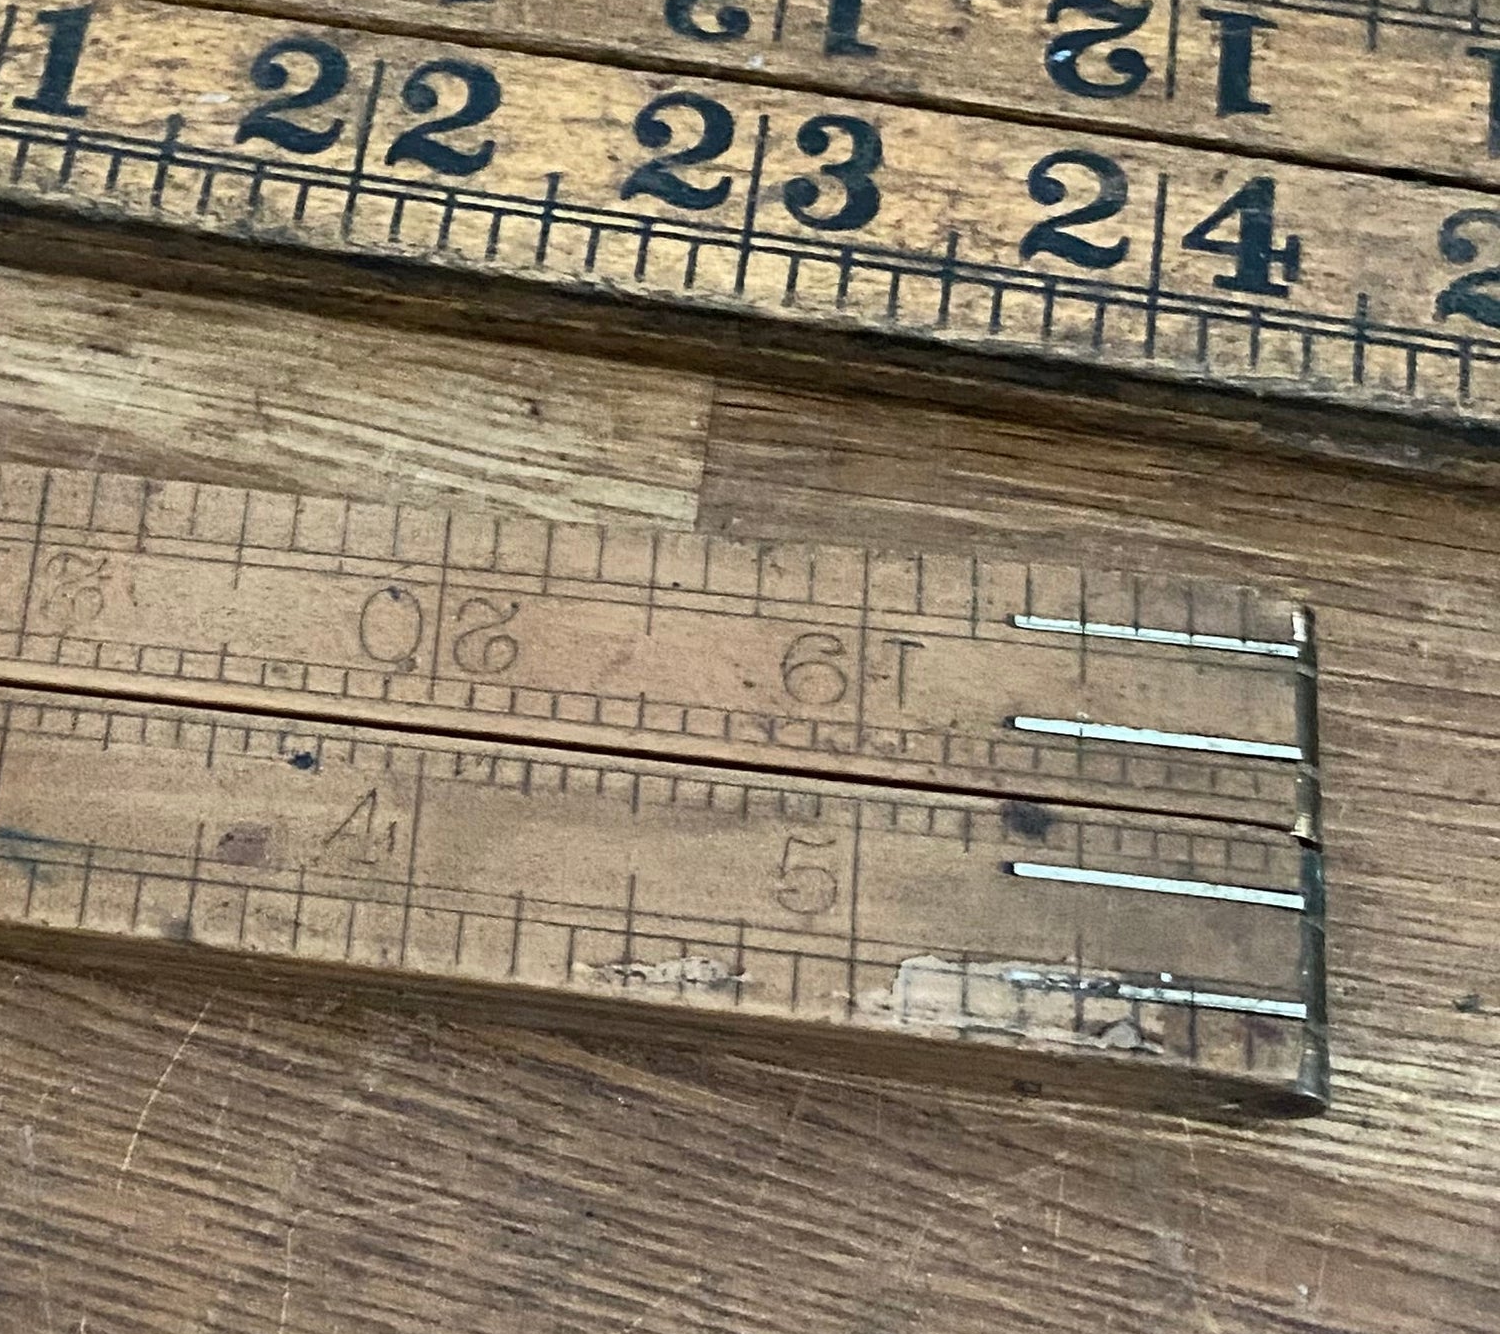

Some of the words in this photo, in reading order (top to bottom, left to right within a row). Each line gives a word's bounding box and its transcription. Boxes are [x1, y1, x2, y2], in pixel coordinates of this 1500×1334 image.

[235, 35, 502, 177] 22
[620, 90, 884, 232] 23
[1018, 148, 1300, 299] 24
[359, 584, 520, 672] 20
[776, 835, 839, 917] 5
